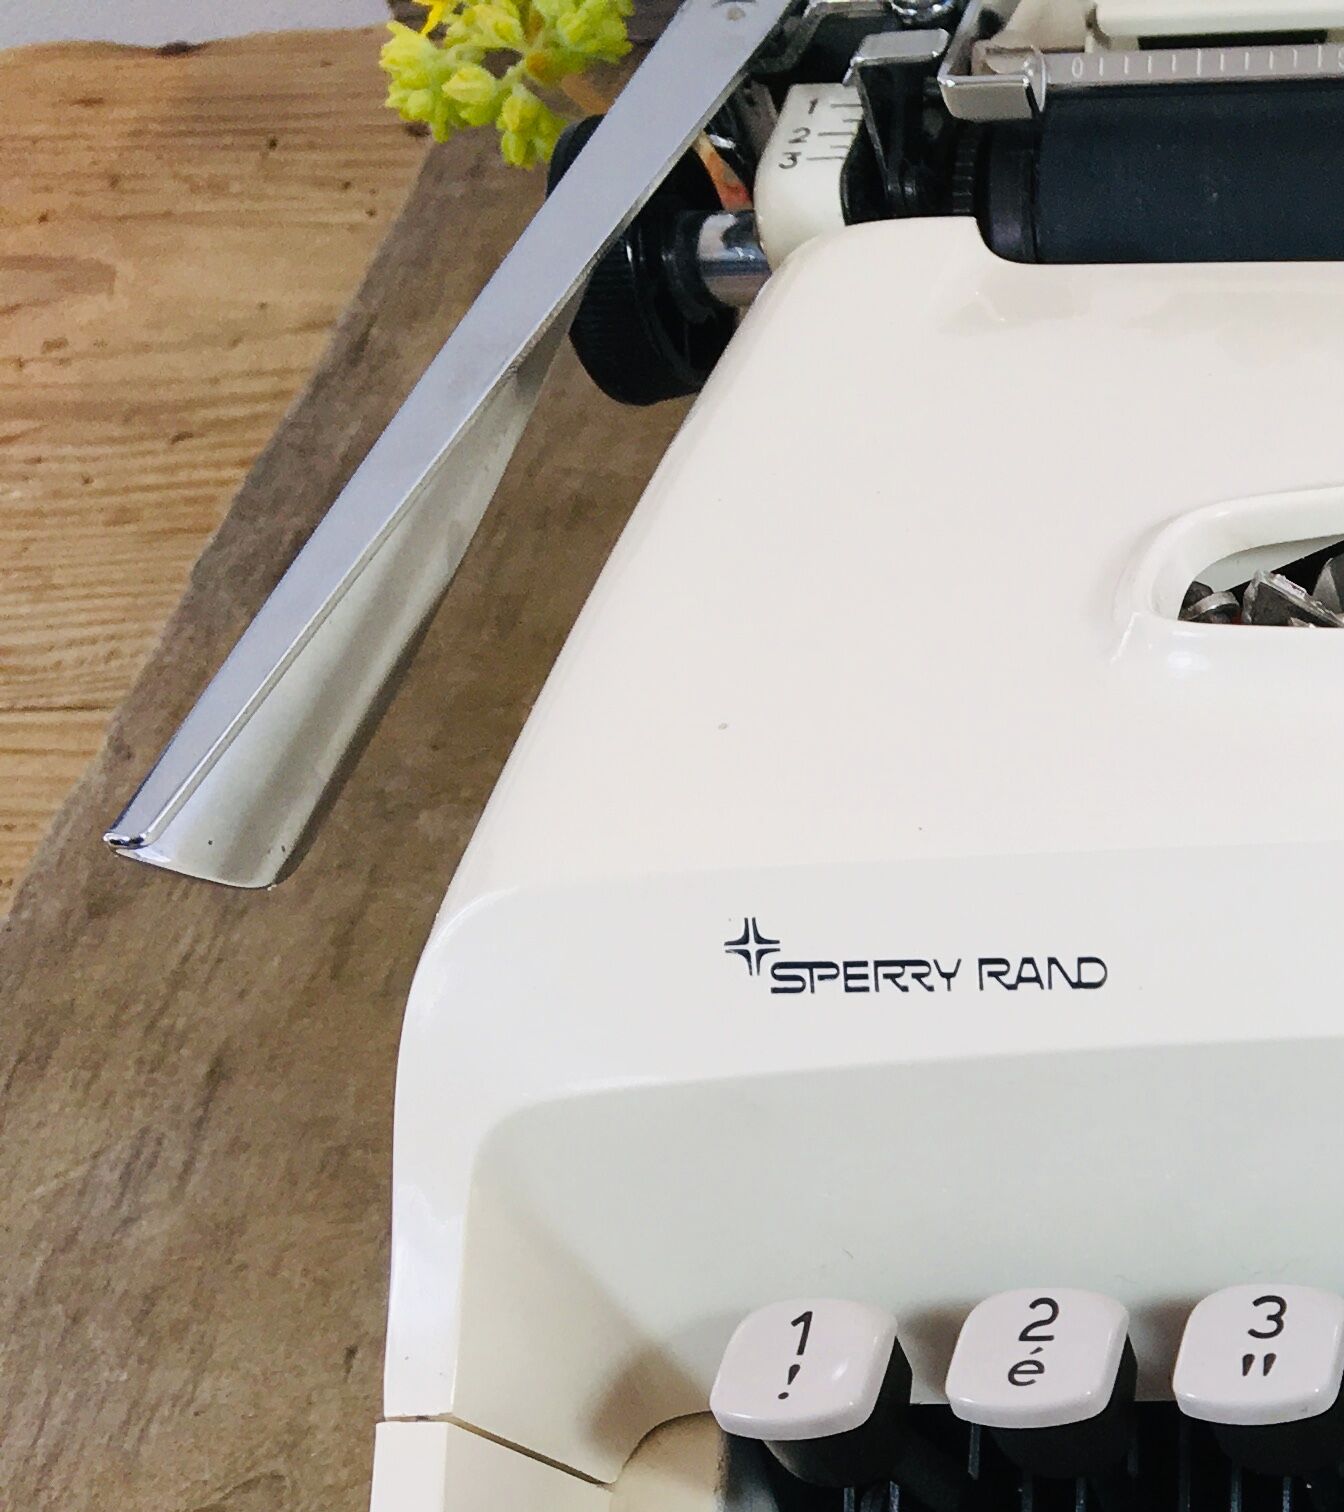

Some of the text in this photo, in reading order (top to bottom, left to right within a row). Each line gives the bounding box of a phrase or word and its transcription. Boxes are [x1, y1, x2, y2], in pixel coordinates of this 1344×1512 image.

[807, 97, 819, 115] 1
[788, 126, 811, 144] 2
[778, 150, 802, 170] 3
[769, 956, 1109, 995] SPERRY RAND
[789, 1309, 815, 1357] 1
[1017, 1296, 1061, 1343] 2
[1246, 1293, 1289, 1341] 3
[776, 1362, 802, 1401] !
[1006, 1350, 1046, 1388] é
